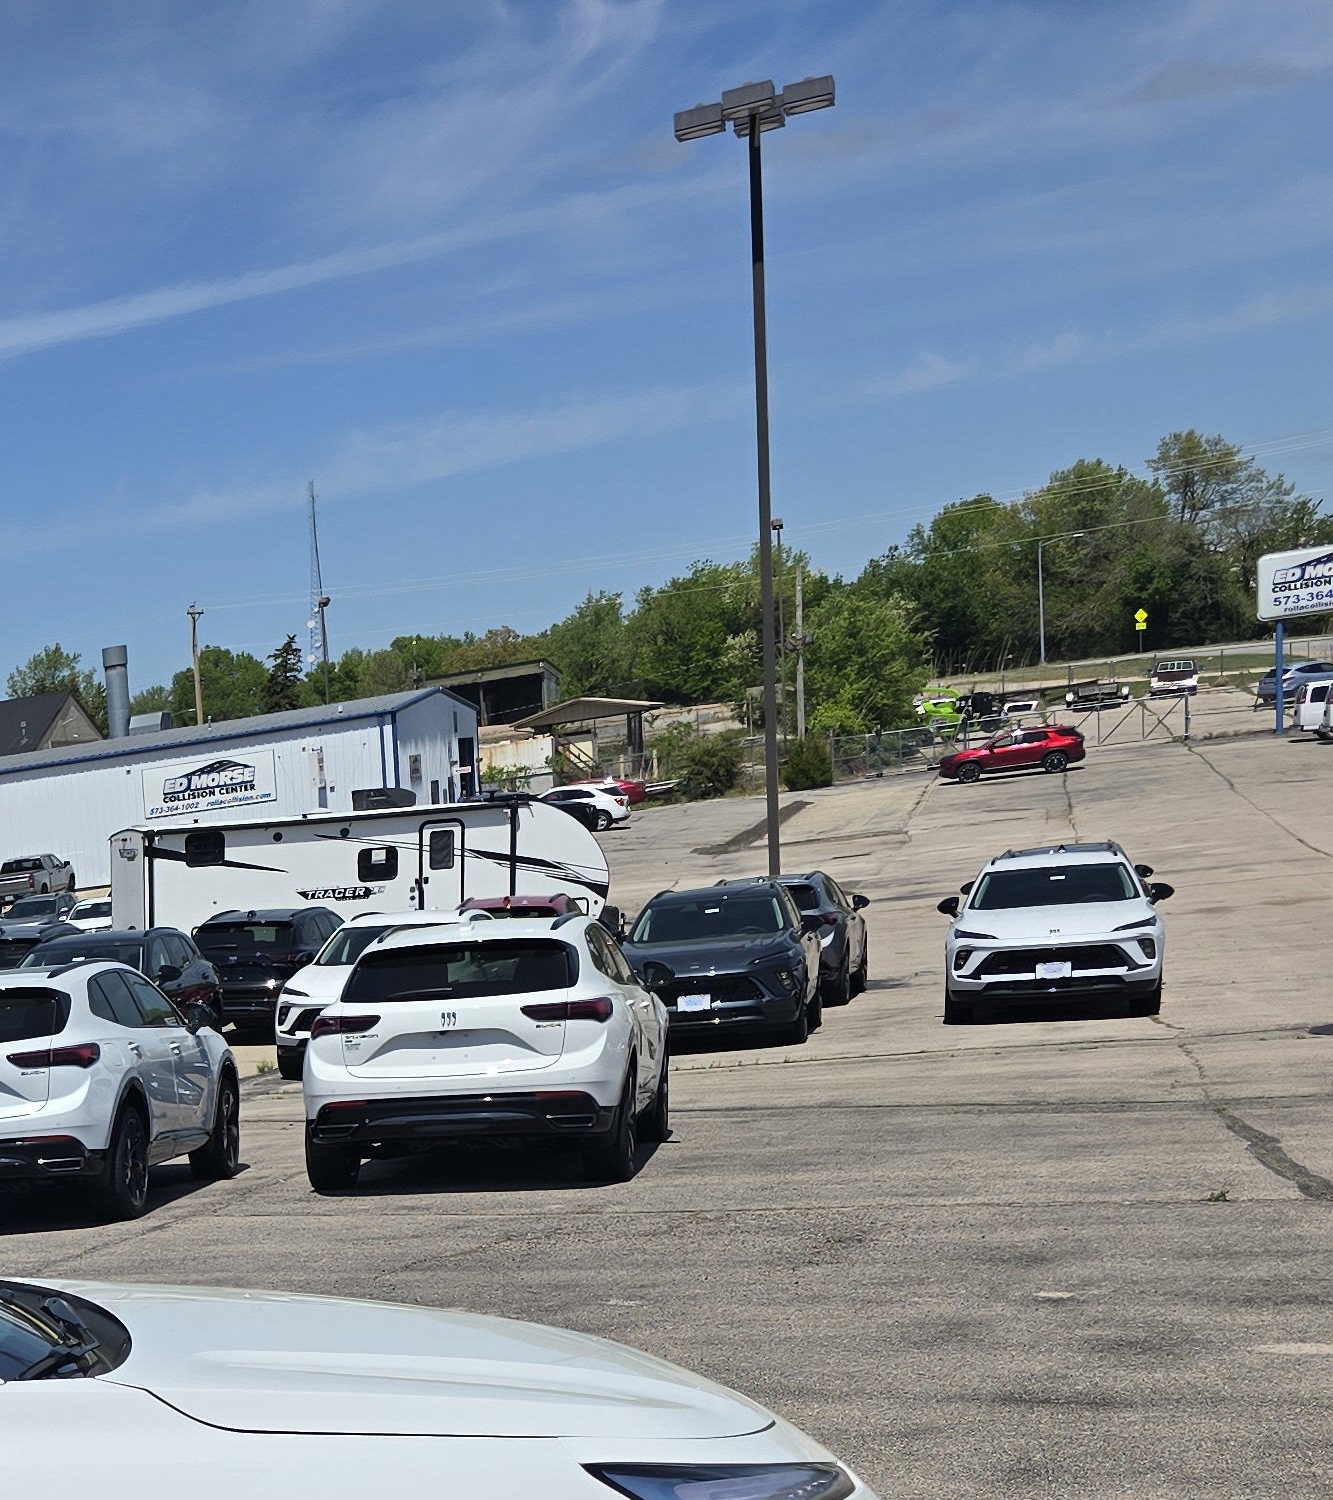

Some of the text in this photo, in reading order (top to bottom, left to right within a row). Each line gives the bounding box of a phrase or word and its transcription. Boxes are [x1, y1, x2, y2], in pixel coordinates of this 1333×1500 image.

[1272, 577, 1331, 593] COLLISION
[1273, 568, 1303, 585] ED
[1273, 589, 1333, 607] 573-364
[1284, 601, 1333, 612] rollacollisi
[163, 766, 255, 795] ED MORSE
[163, 783, 256, 803] COLLISION CENTER
[306, 887, 366, 900] TRACER
